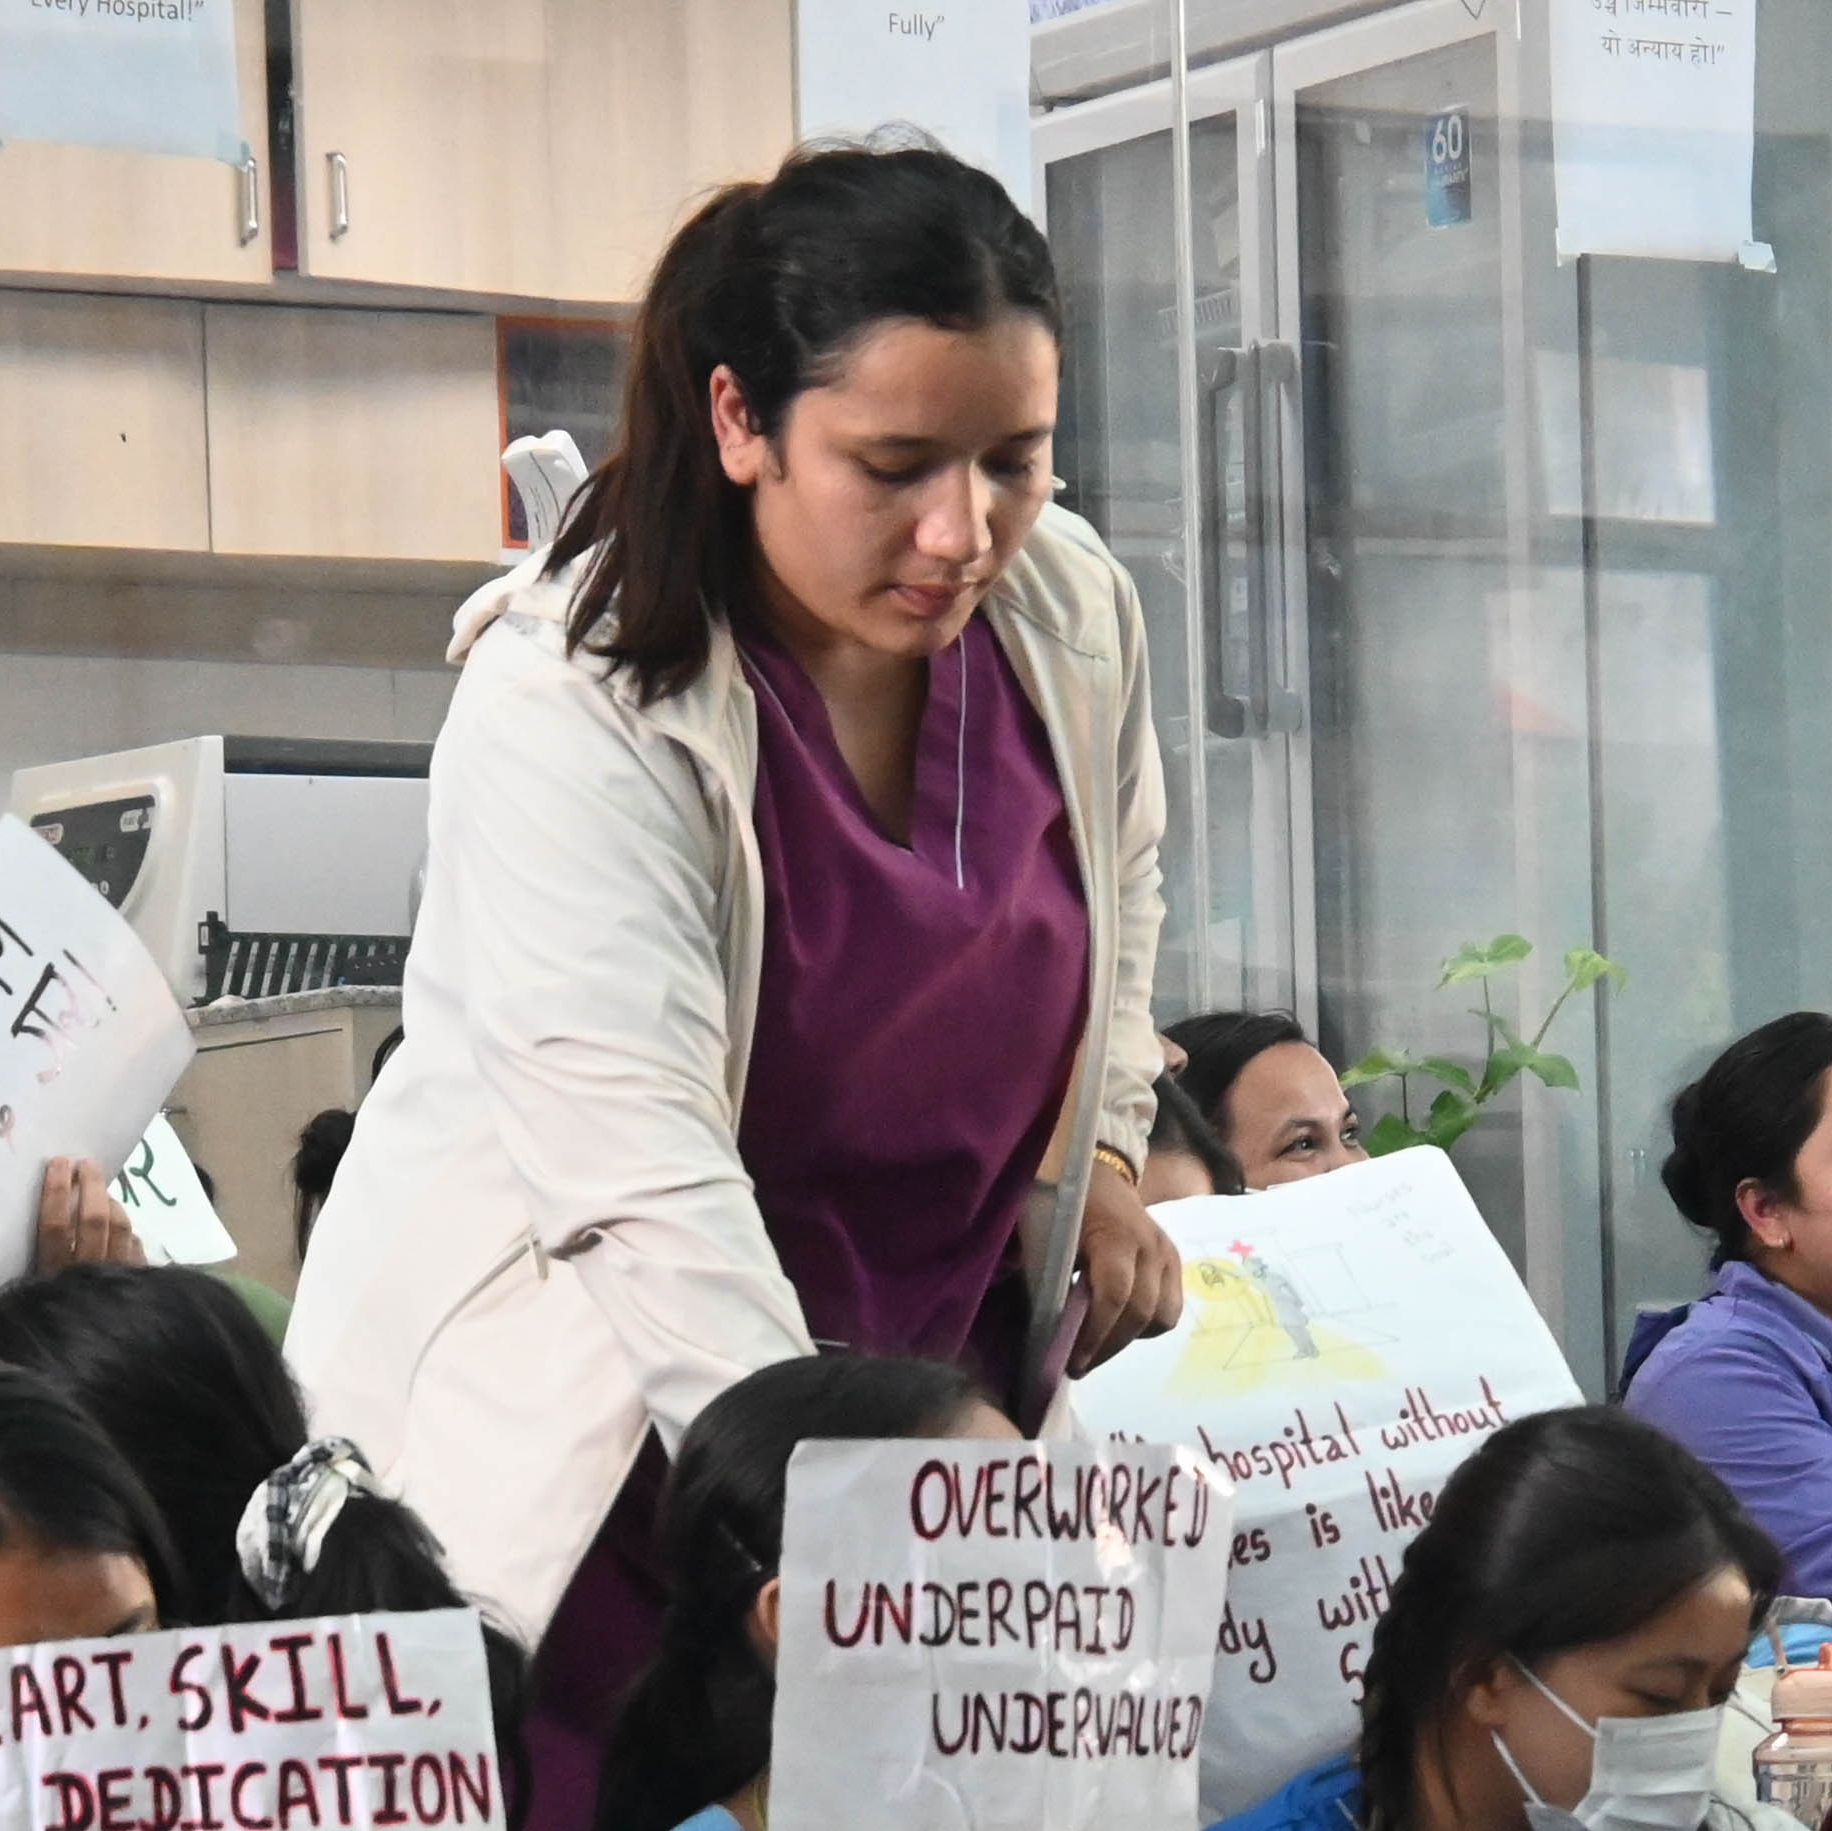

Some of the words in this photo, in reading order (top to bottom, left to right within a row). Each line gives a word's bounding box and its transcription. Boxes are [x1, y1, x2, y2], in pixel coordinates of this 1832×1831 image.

[888, 13, 945, 41] Fully”
[1600, 29, 1621, 56] यो
[1628, 38, 1685, 60] अन्याय
[1432, 114, 1462, 164] 60
[1197, 1401, 1361, 1490] hospital
[1381, 1374, 1509, 1452] without
[910, 1456, 1210, 1549] OVERWORKED
[1305, 1502, 1342, 1549] is
[1365, 1467, 1435, 1533] like
[824, 1577, 1137, 1656] UNDERPAID
[169, 1632, 444, 1735] SKILL,
